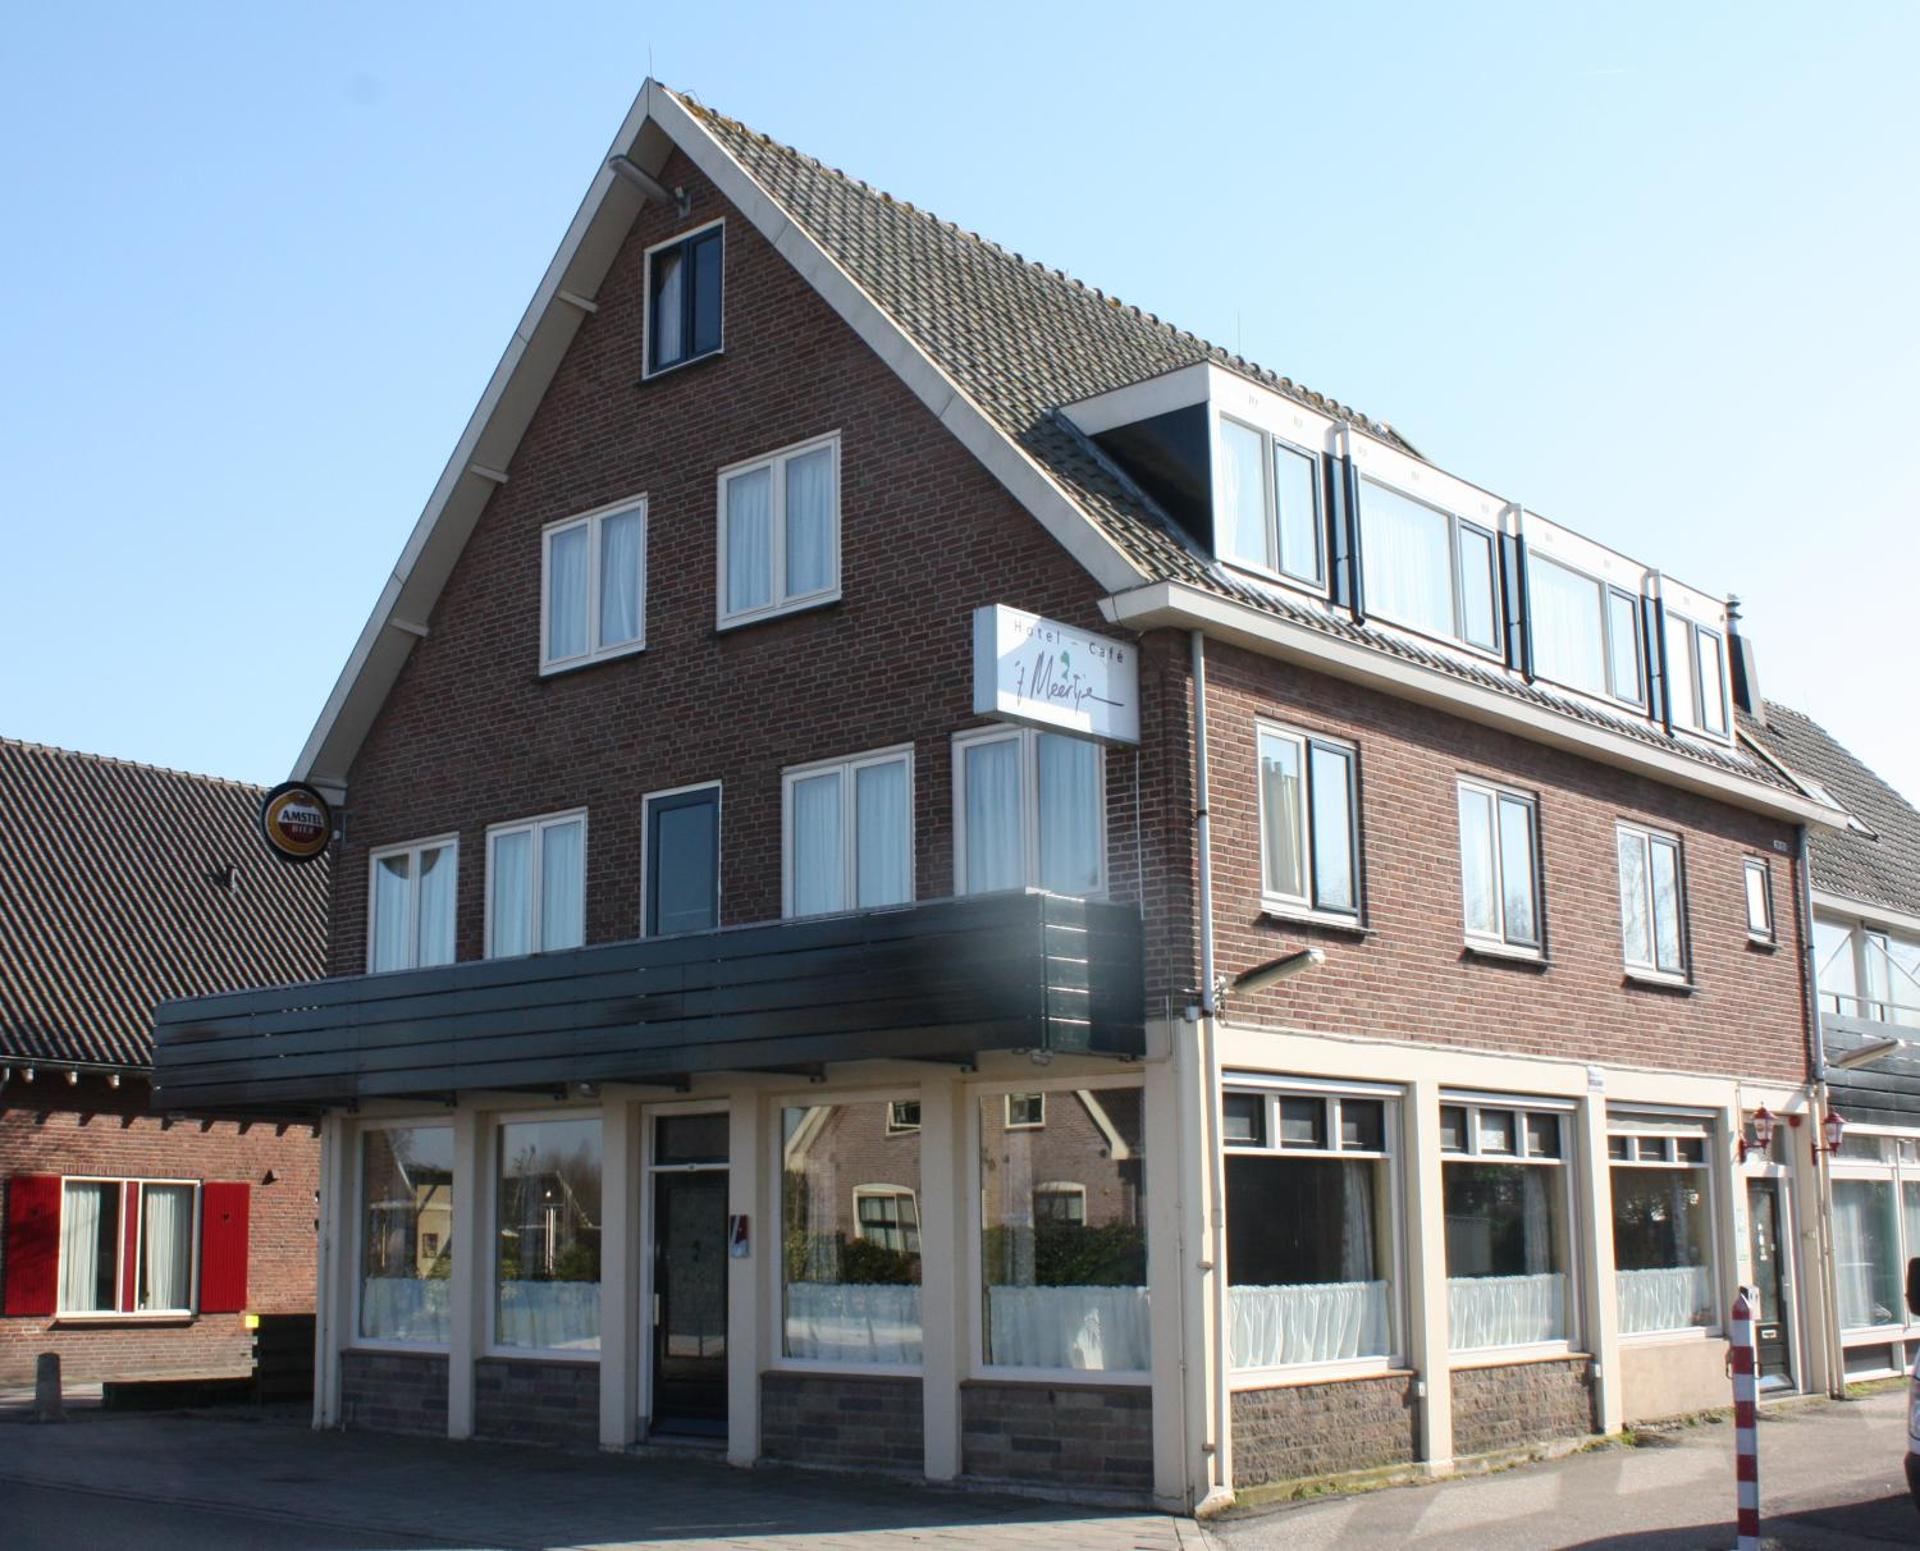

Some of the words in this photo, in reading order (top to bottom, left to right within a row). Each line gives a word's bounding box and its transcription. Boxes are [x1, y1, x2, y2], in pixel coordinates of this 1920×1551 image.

[1014, 620, 1060, 645] Hotel
[1088, 642, 1124, 664] Café
[281, 809, 322, 826] AMSTEL
[291, 824, 315, 834] BIER
